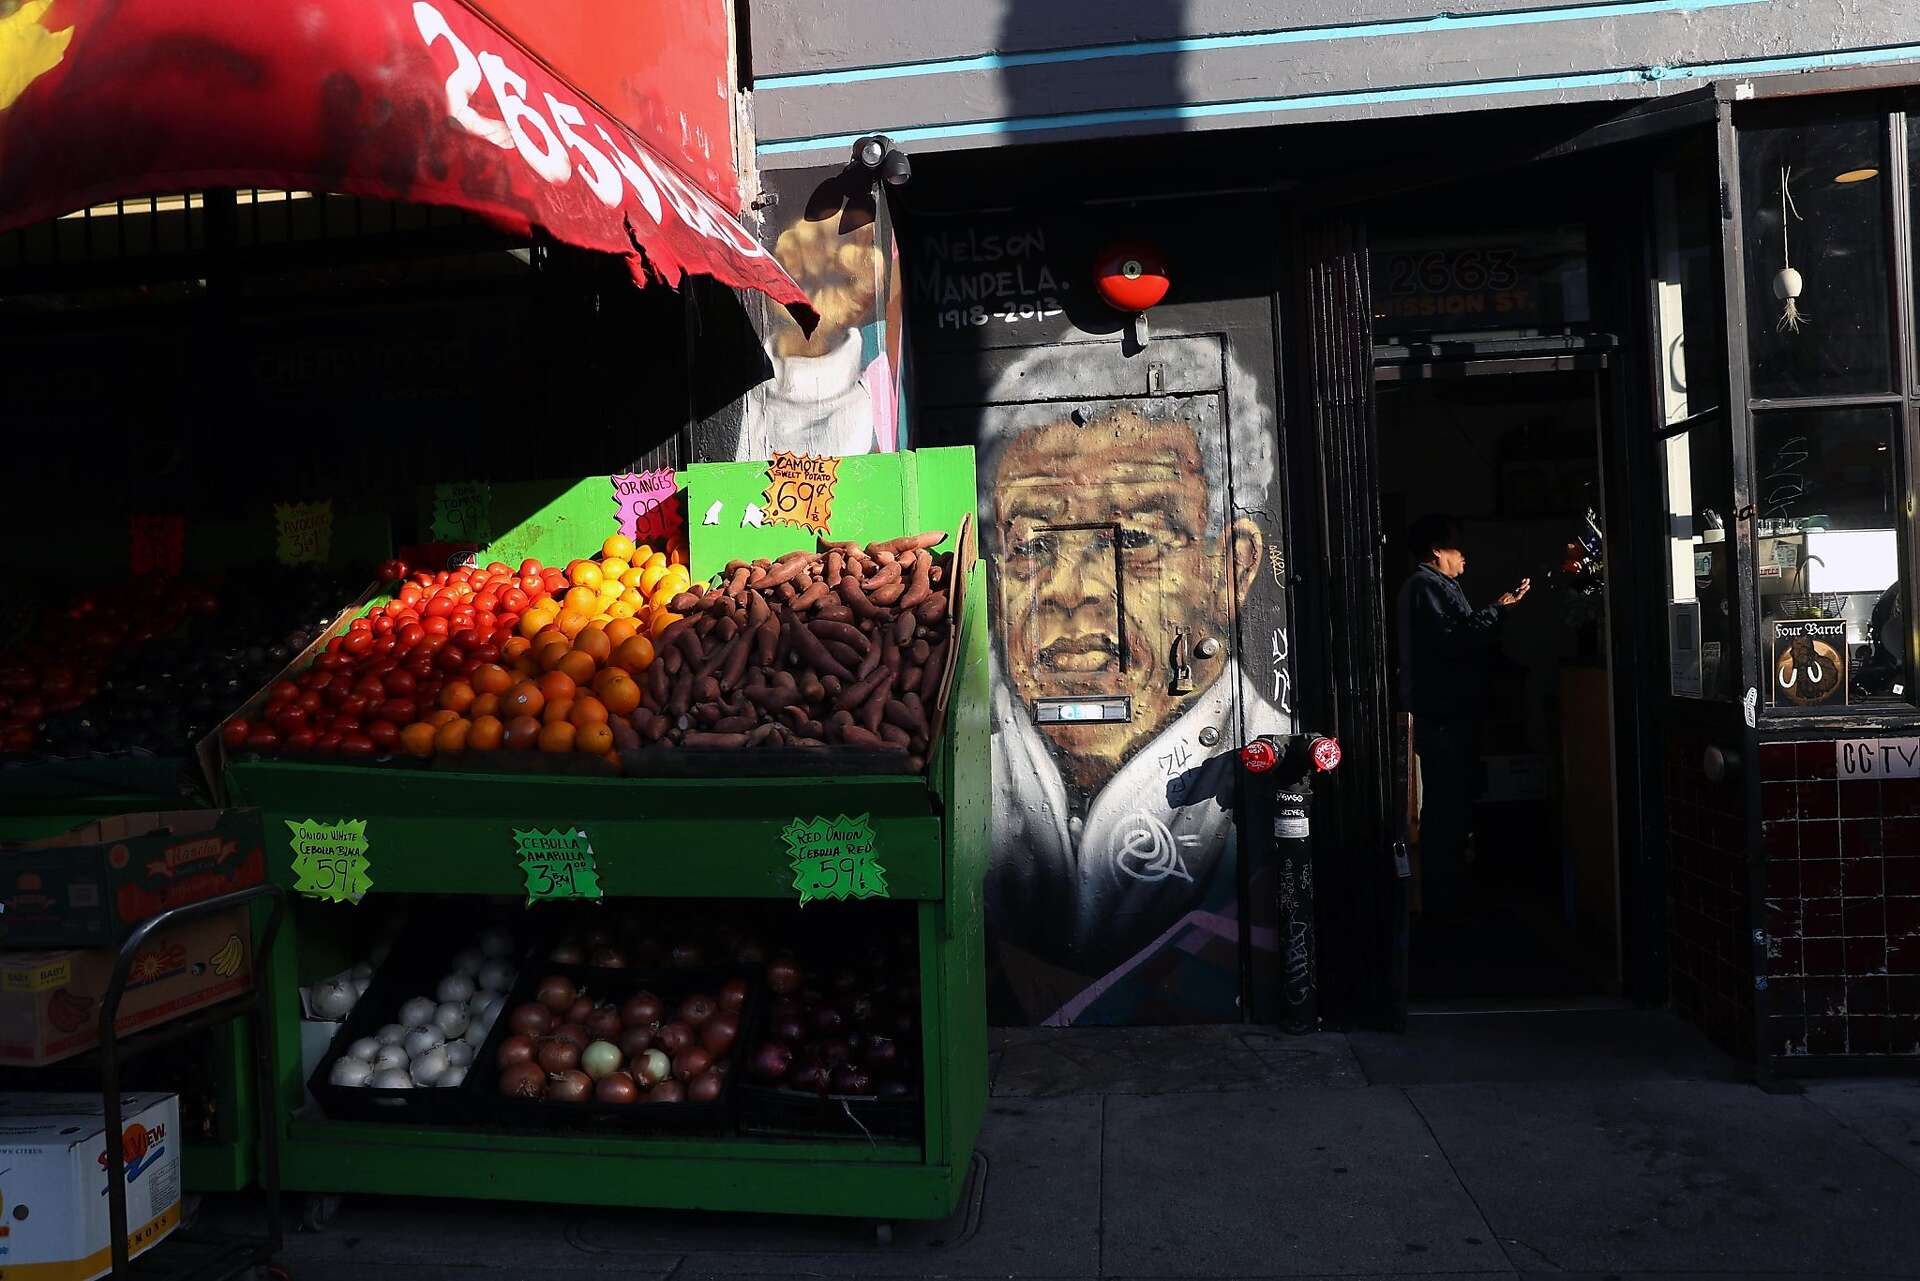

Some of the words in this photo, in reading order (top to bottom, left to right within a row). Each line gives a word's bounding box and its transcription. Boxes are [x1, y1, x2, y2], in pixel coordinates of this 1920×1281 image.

[922, 226, 1048, 264] NELSON
[1391, 248, 1520, 297] 2663
[937, 296, 1064, 330] 1918-2013
[776, 456, 825, 473] CAMOTE
[619, 470, 673, 496] ORANGES
[774, 469, 802, 479] SWEET
[804, 471, 831, 481] POTATO
[1775, 623, 1802, 639] Four
[1804, 621, 1846, 636] Barrel
[300, 827, 328, 840] ONION
[330, 830, 358, 841] WHITE
[791, 828, 822, 845] RED
[826, 826, 863, 842] ONION
[521, 837, 580, 850] CEBOLLA
[799, 845, 841, 860] CEBOLLA
[846, 841, 873, 855] RED
[527, 851, 585, 863] AMARILLA
